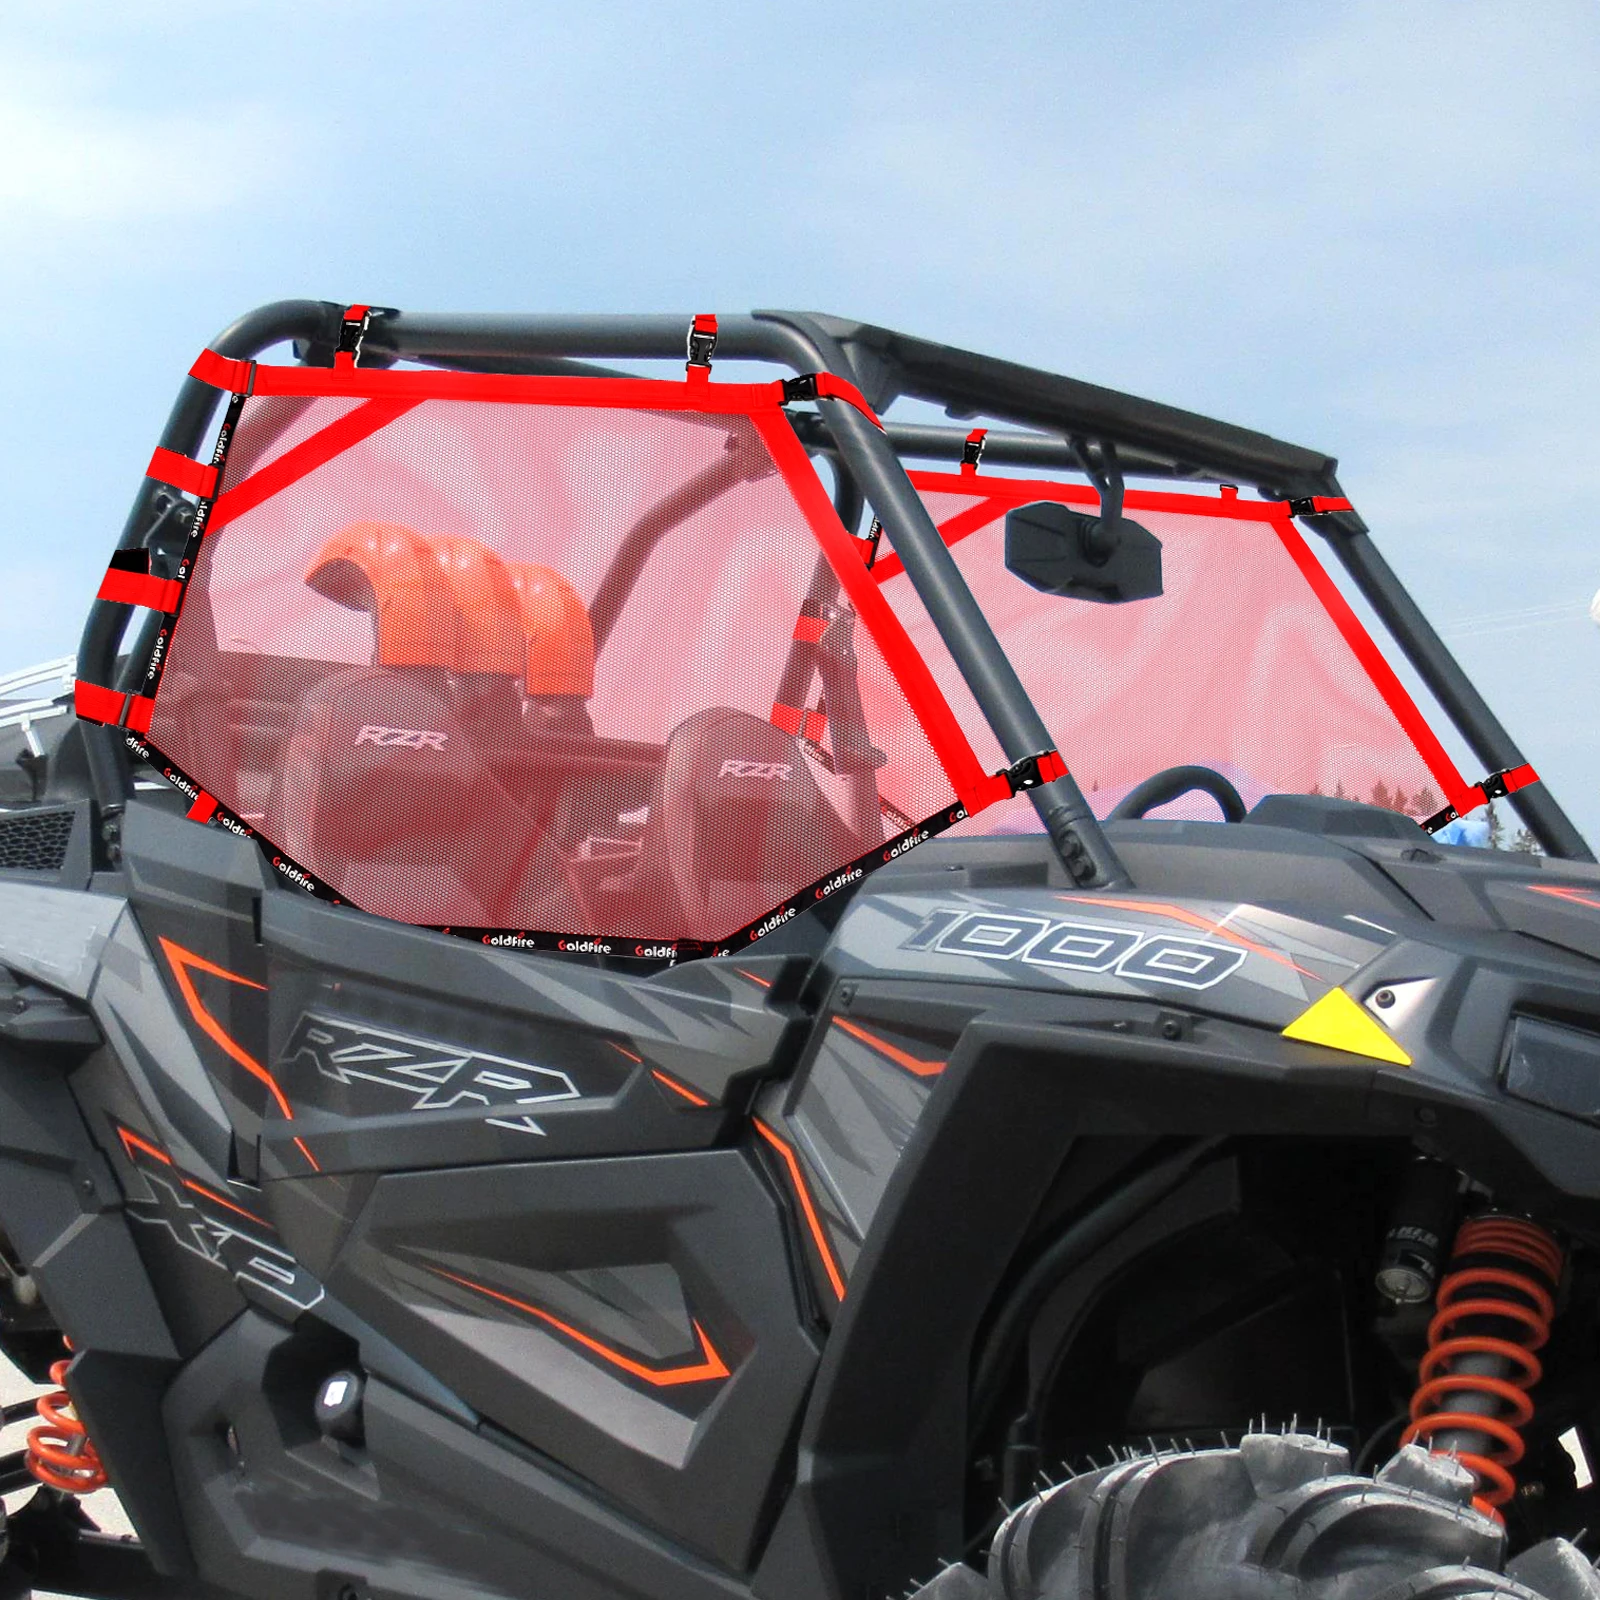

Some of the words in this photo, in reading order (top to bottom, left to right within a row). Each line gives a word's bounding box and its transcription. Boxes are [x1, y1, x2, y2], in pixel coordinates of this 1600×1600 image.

[213, 423, 231, 464] Goldfir
[190, 500, 208, 537] ldfire
[147, 627, 167, 680] Goldfire
[126, 737, 150, 759] dfire
[883, 827, 929, 862] Goldfire
[272, 856, 314, 892] Goldfire
[815, 865, 863, 900] Goldfire
[482, 931, 534, 948] Goldfire
[749, 905, 797, 941] Goldfire
[557, 937, 611, 954] Goldfire
[899, 908, 1245, 990] 1000
